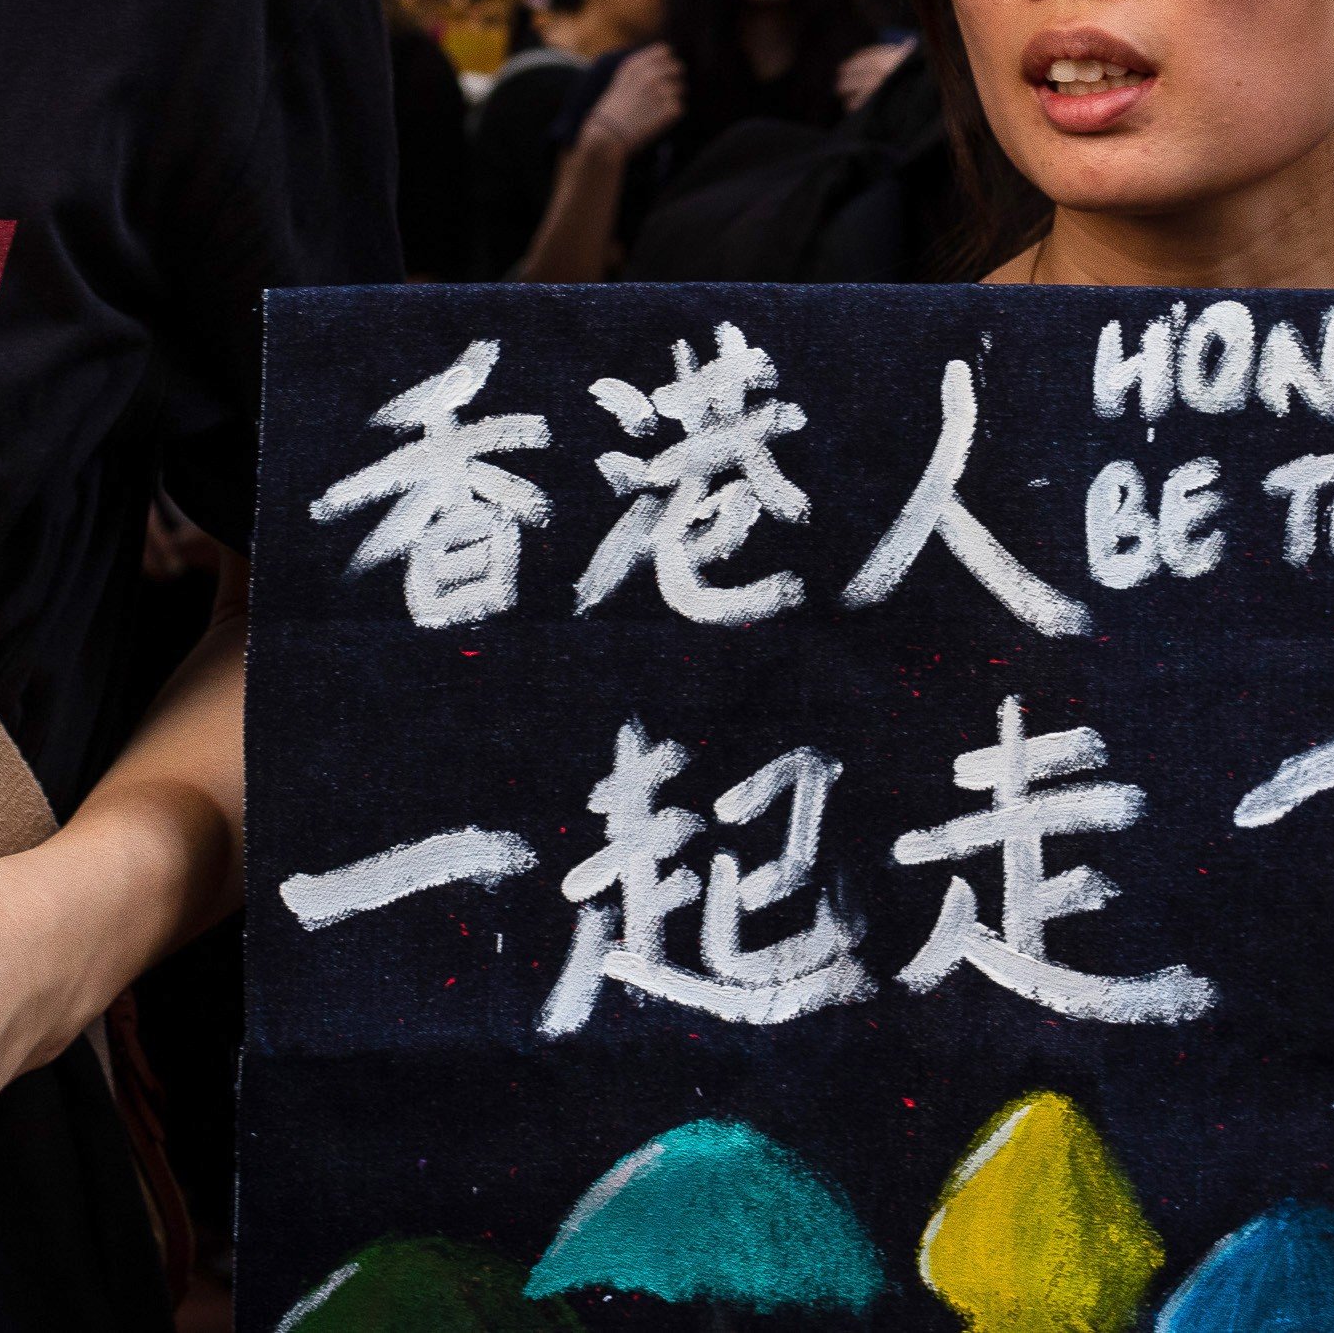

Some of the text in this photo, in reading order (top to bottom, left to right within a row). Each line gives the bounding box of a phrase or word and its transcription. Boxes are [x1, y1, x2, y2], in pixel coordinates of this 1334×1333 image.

[309, 321, 1093, 638] 香港人
[1085, 458, 1225, 590] BE
